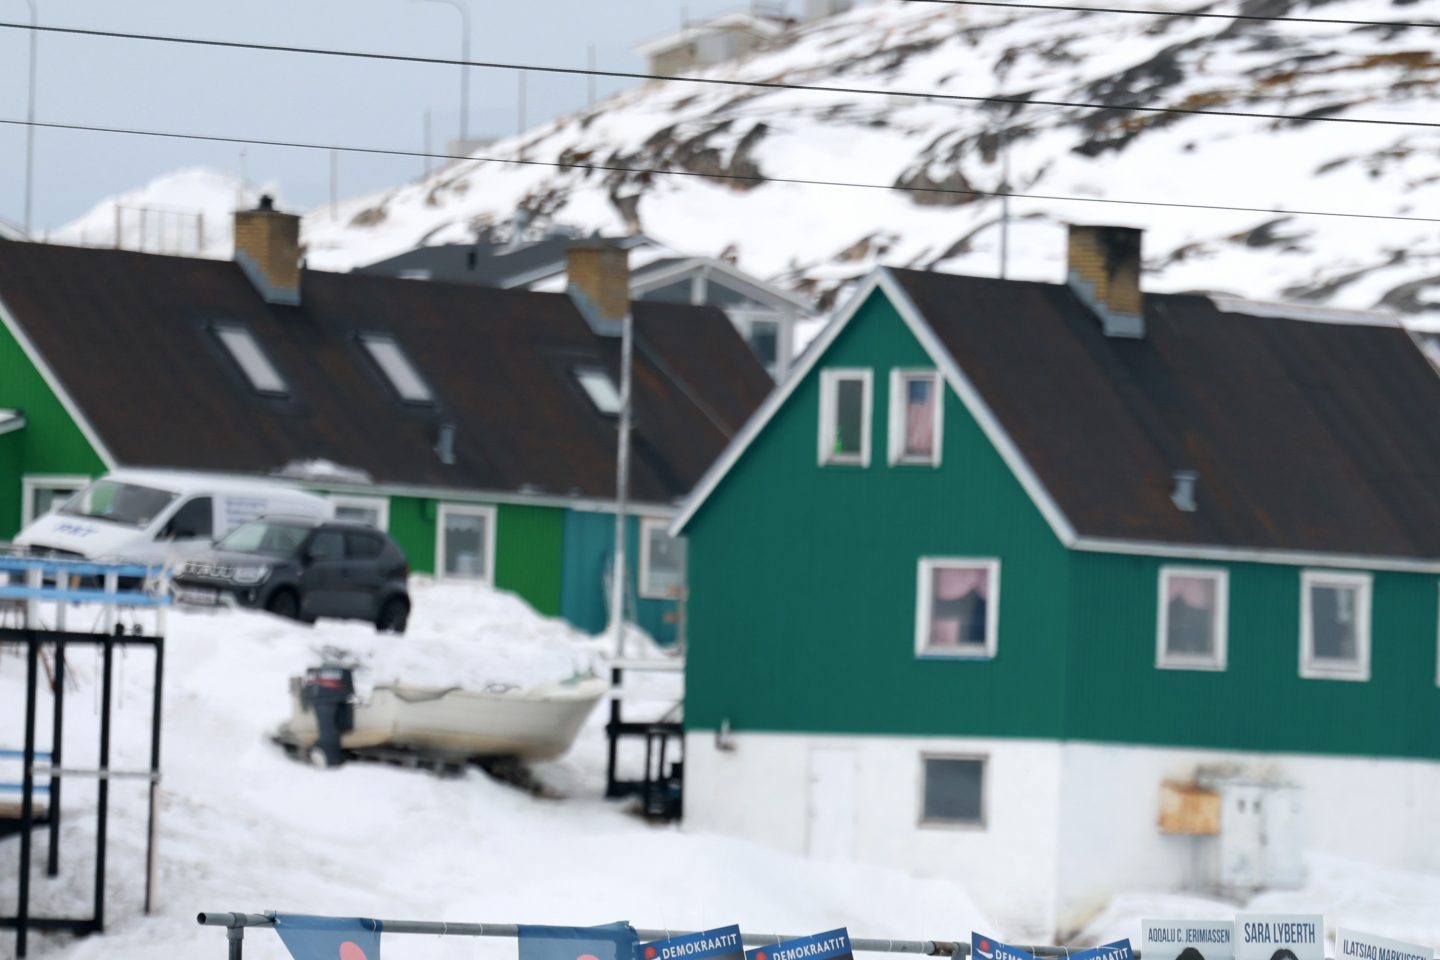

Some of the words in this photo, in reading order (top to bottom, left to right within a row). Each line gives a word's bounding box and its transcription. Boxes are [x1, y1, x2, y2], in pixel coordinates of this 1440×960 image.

[1148, 928, 1175, 943] AQQALU
[1177, 928, 1184, 943] C.
[1185, 928, 1230, 944] JERIMIASSEN
[1244, 923, 1271, 943] SARA
[1273, 923, 1316, 944] LYBERTH
[663, 934, 737, 960] DEMOKRAATIT
